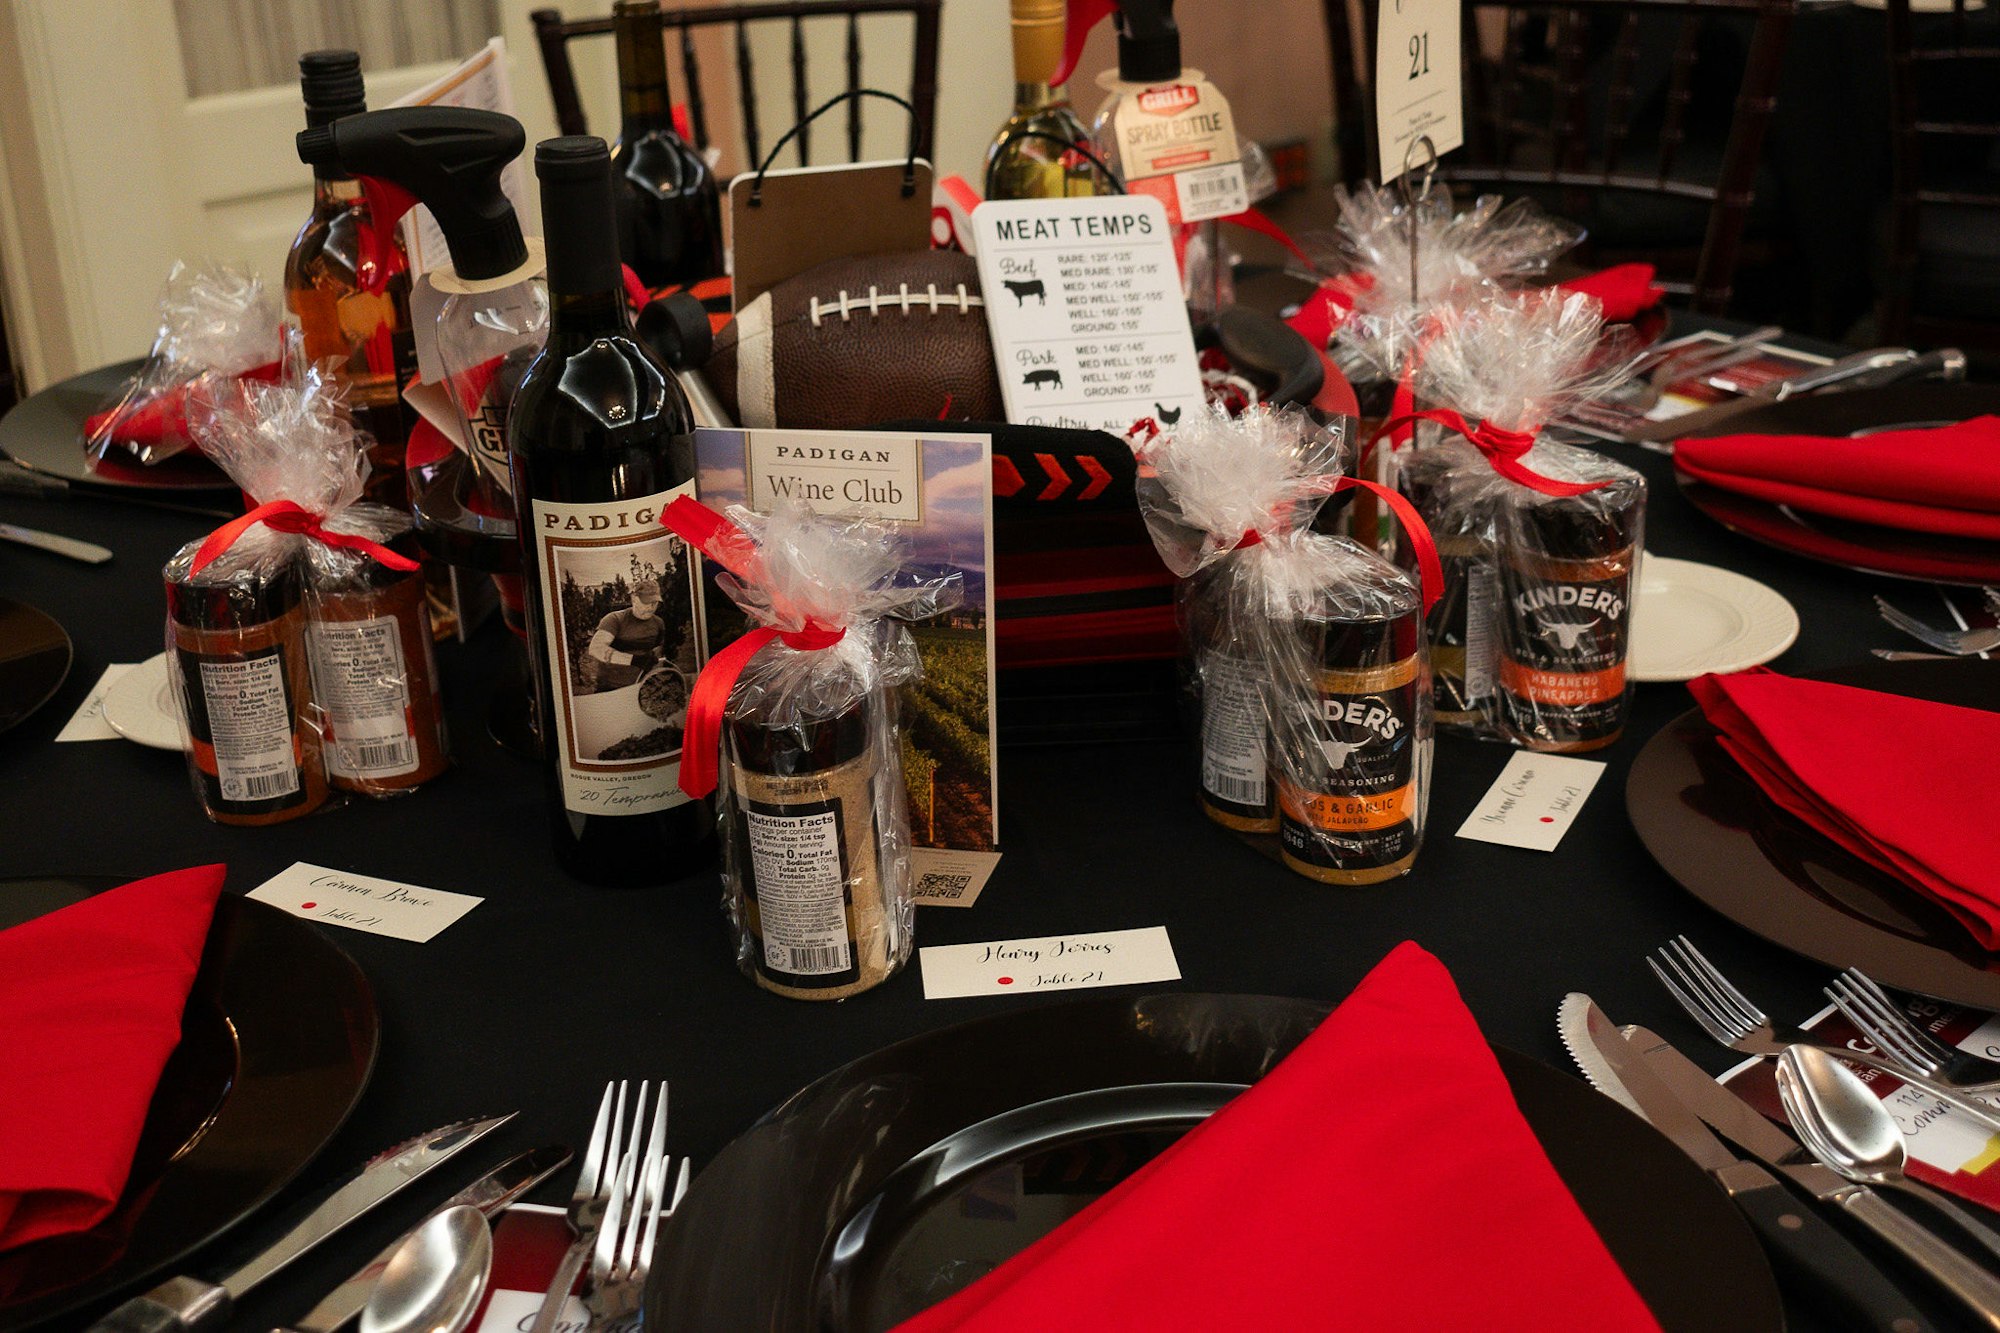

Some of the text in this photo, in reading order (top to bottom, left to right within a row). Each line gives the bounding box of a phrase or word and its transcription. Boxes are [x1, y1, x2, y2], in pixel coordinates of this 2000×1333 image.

[1408, 30, 1429, 80] 21
[1127, 112, 1223, 145] SPRAY BOTTLE
[996, 214, 1153, 241] MEAT TEMPS
[999, 257, 1038, 277] Beef
[1061, 268, 1083, 277] MED
[1066, 296, 1088, 305] MED
[1016, 349, 1056, 366] Pork
[1079, 359, 1101, 369] MED
[777, 446, 890, 463] PADIGAN
[767, 475, 903, 504] Wine Club
[544, 503, 668, 531] PADIG
[1514, 586, 1623, 620] KINDER'S
[201, 658, 278, 673] Nutrition Facts
[1531, 674, 1599, 688] HABANERO
[1530, 686, 1599, 701] PINEAPPLE
[1288, 699, 1402, 740] NDER'S
[1322, 774, 1395, 787] SEASONING
[603, 786, 682, 808] Temprani
[1331, 799, 1393, 814] & GARLIC
[749, 814, 834, 828] Nutrition Facts
[762, 833, 779, 841] Serv.
[776, 828, 788, 836] per
[789, 826, 822, 835] container
[763, 840, 785, 849] Amount
[752, 846, 785, 859] Calories
[798, 851, 818, 859] Total
[820, 849, 833, 857] Fat
[778, 865, 797, 873] Total
[799, 865, 819, 873] Carb.
[779, 872, 806, 880] Protein
[309, 874, 370, 896] Carmen
[320, 908, 384, 927] Table 21
[976, 937, 1117, 964] Henry Torres
[1030, 971, 1104, 987] Table 21
